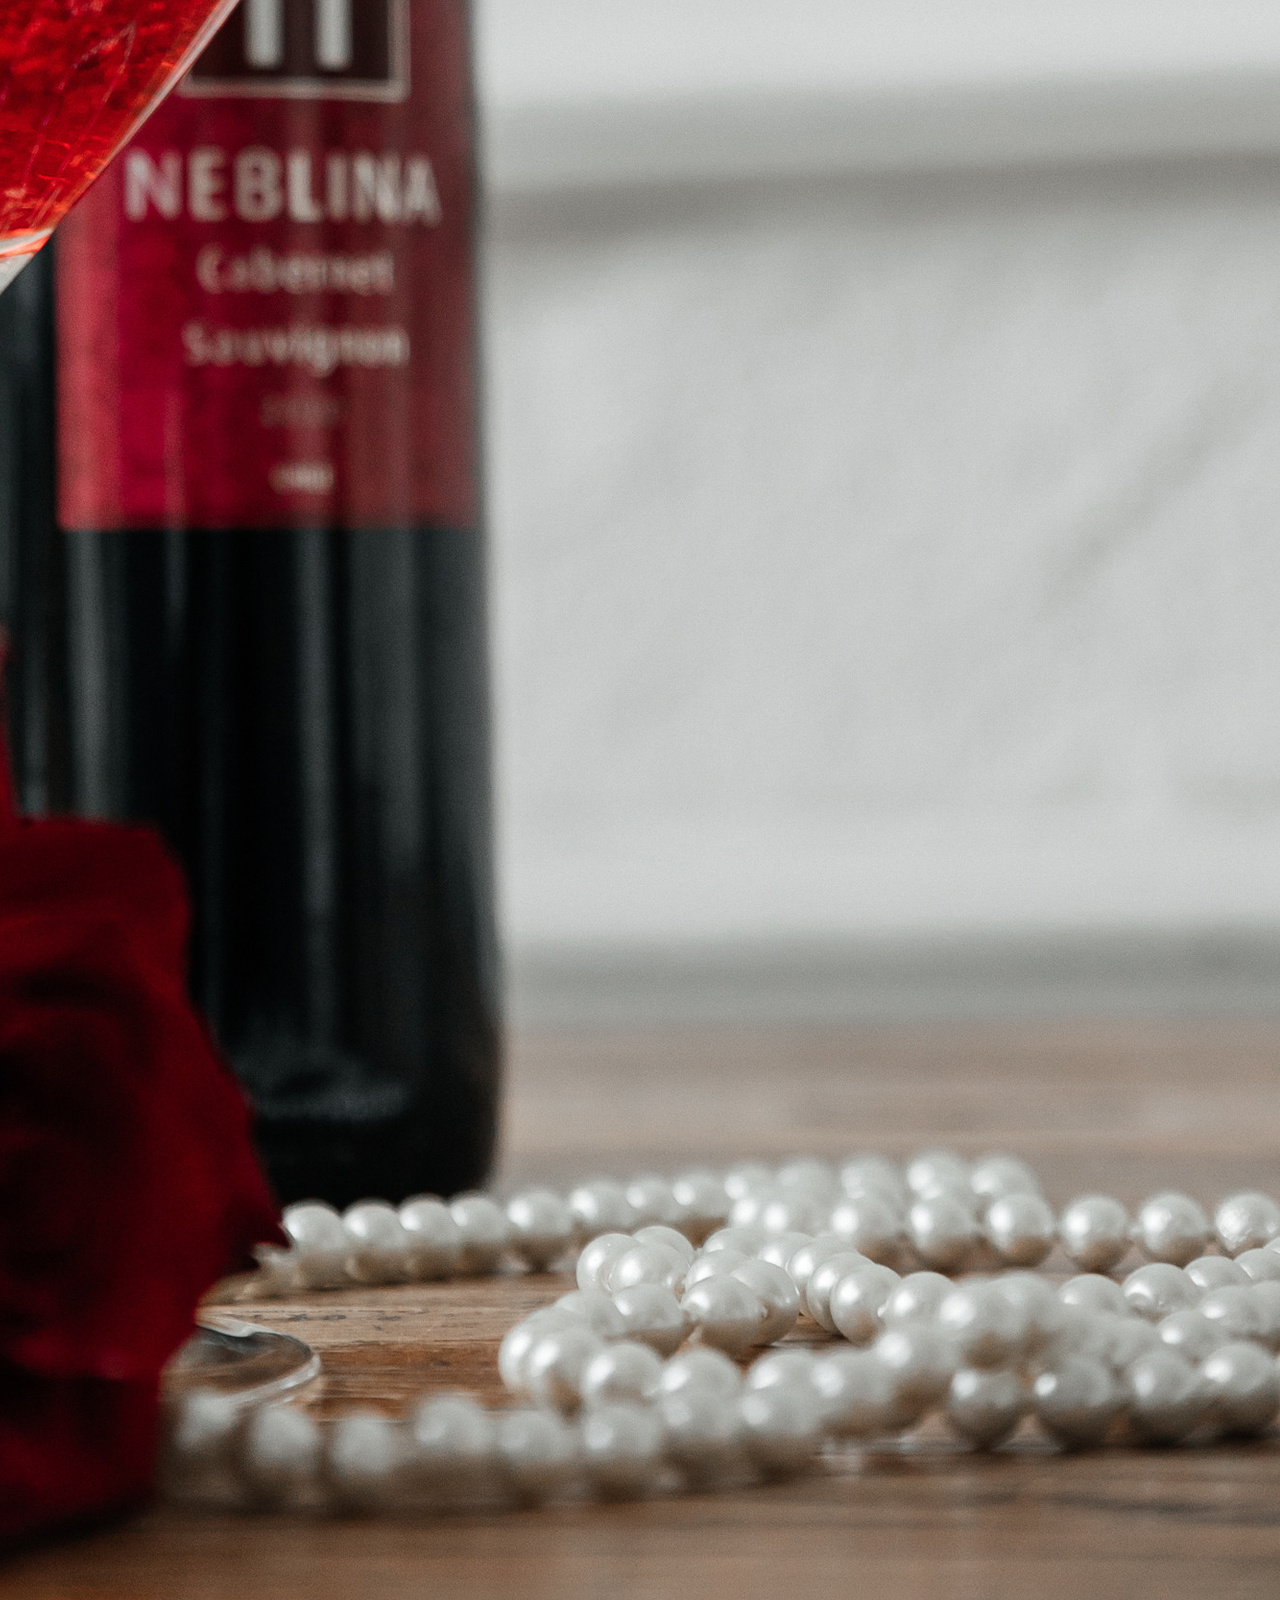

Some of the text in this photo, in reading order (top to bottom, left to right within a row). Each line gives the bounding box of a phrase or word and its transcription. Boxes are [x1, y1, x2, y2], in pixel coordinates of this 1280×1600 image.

[125, 147, 441, 225] NEBLINA
[197, 246, 394, 293] Cabernet
[182, 320, 410, 376] Sauvignon
